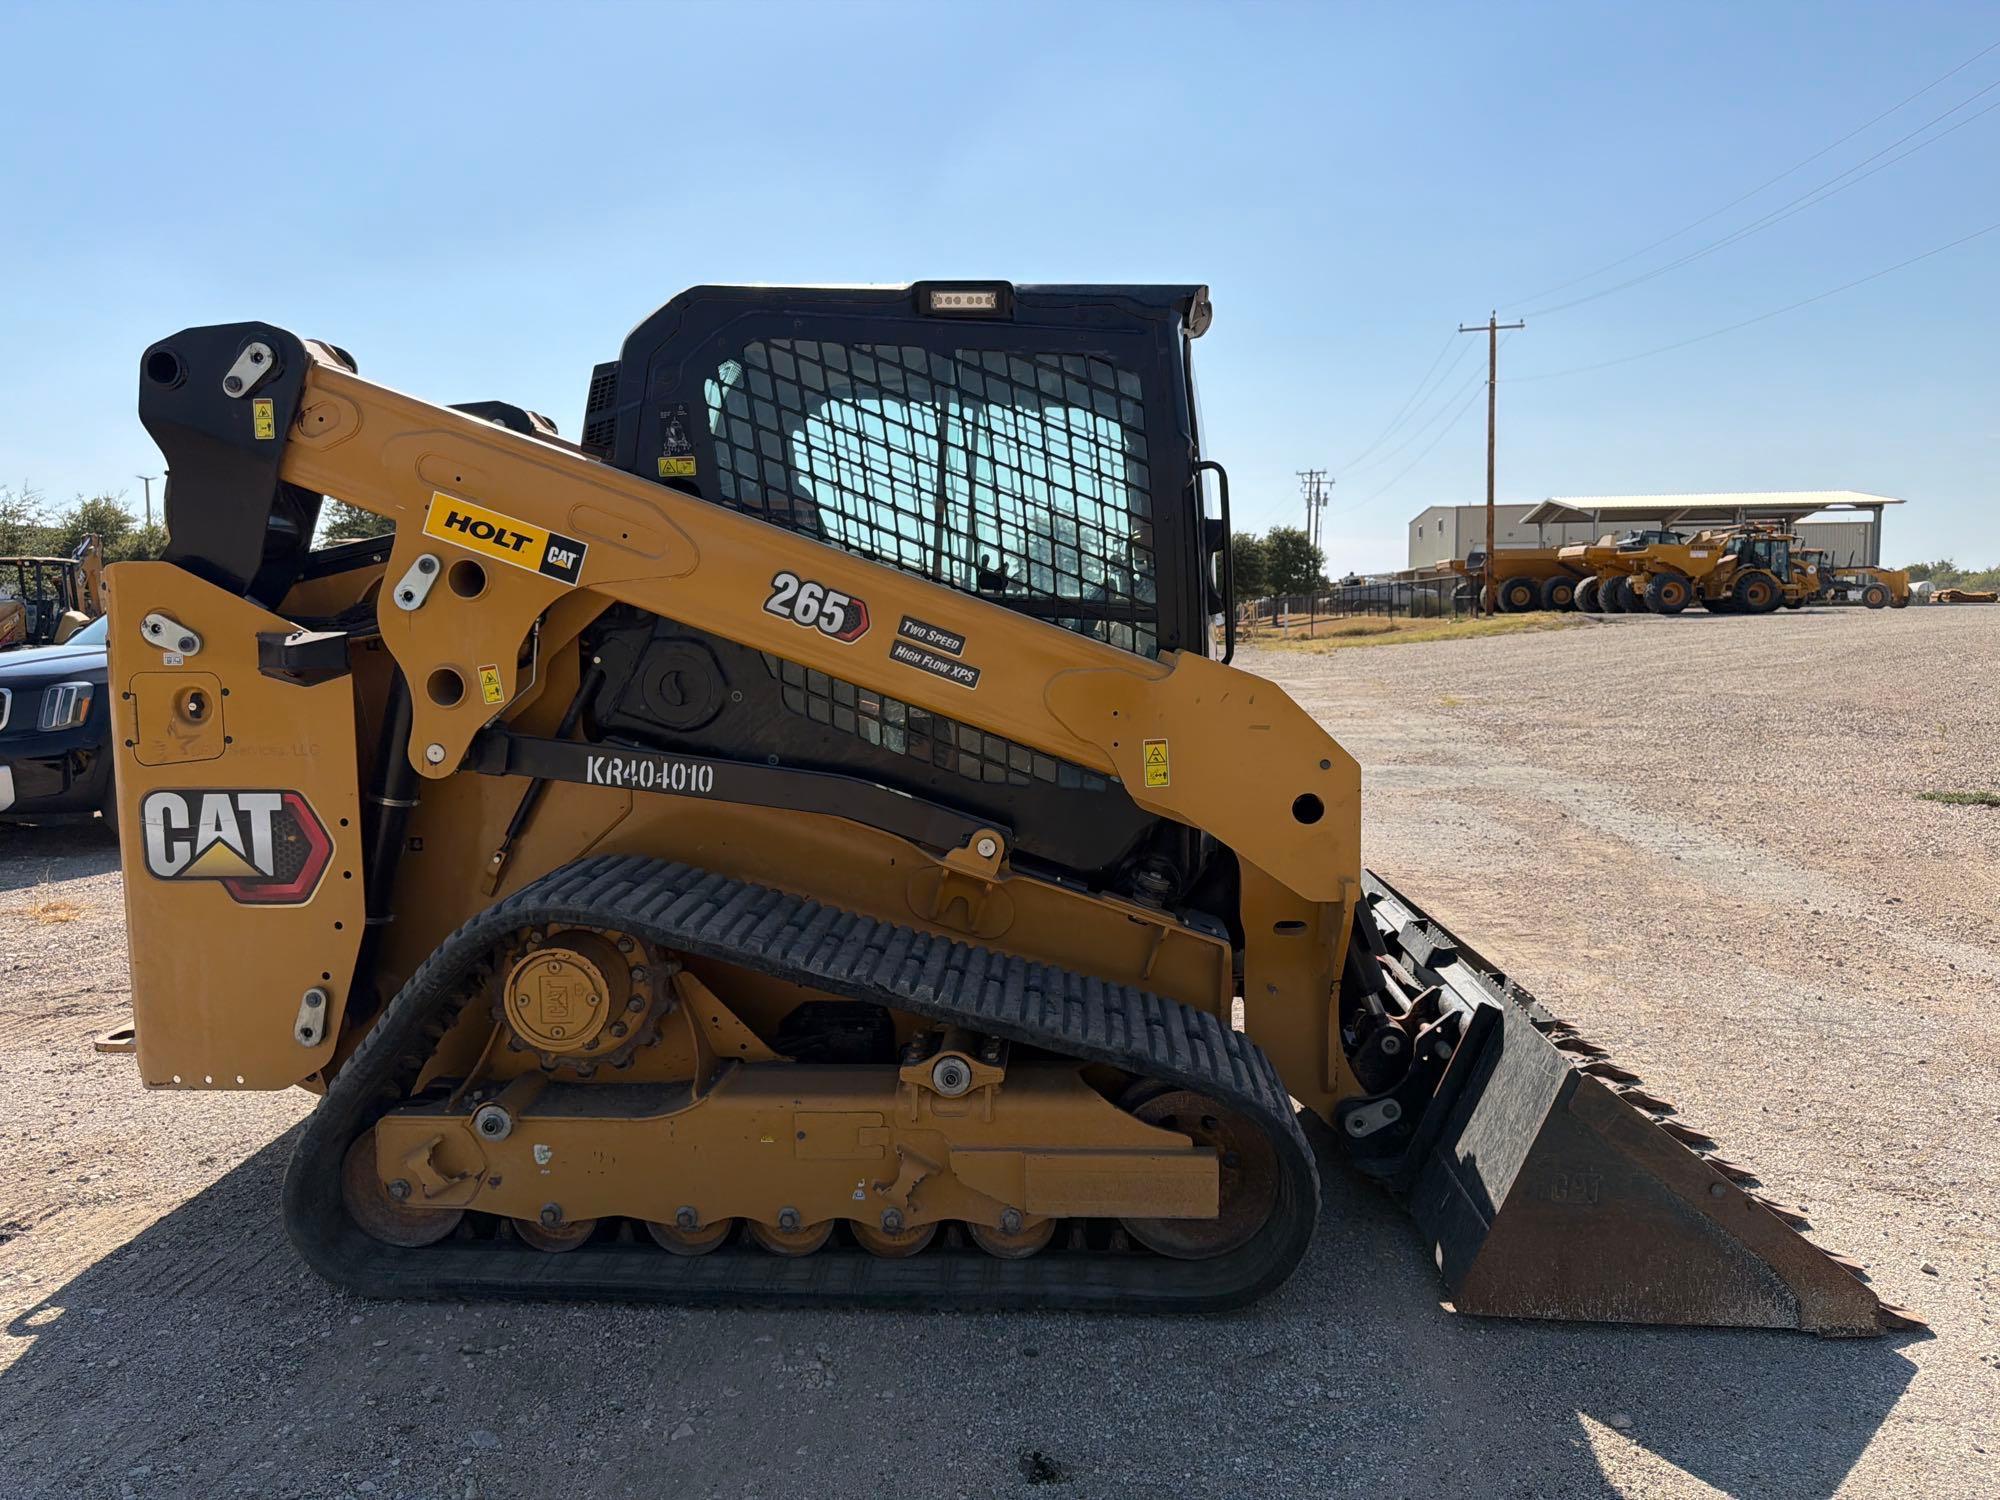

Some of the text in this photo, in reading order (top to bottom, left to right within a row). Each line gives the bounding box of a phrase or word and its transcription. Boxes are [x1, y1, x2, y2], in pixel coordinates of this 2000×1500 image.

[444, 510, 534, 552] HOLT
[547, 546, 577, 570] CAT
[765, 573, 850, 634] 265
[950, 666, 975, 682] XPS
[586, 755, 714, 793] KR404010
[144, 791, 282, 877] CAT
[546, 981, 569, 1018] CAT
